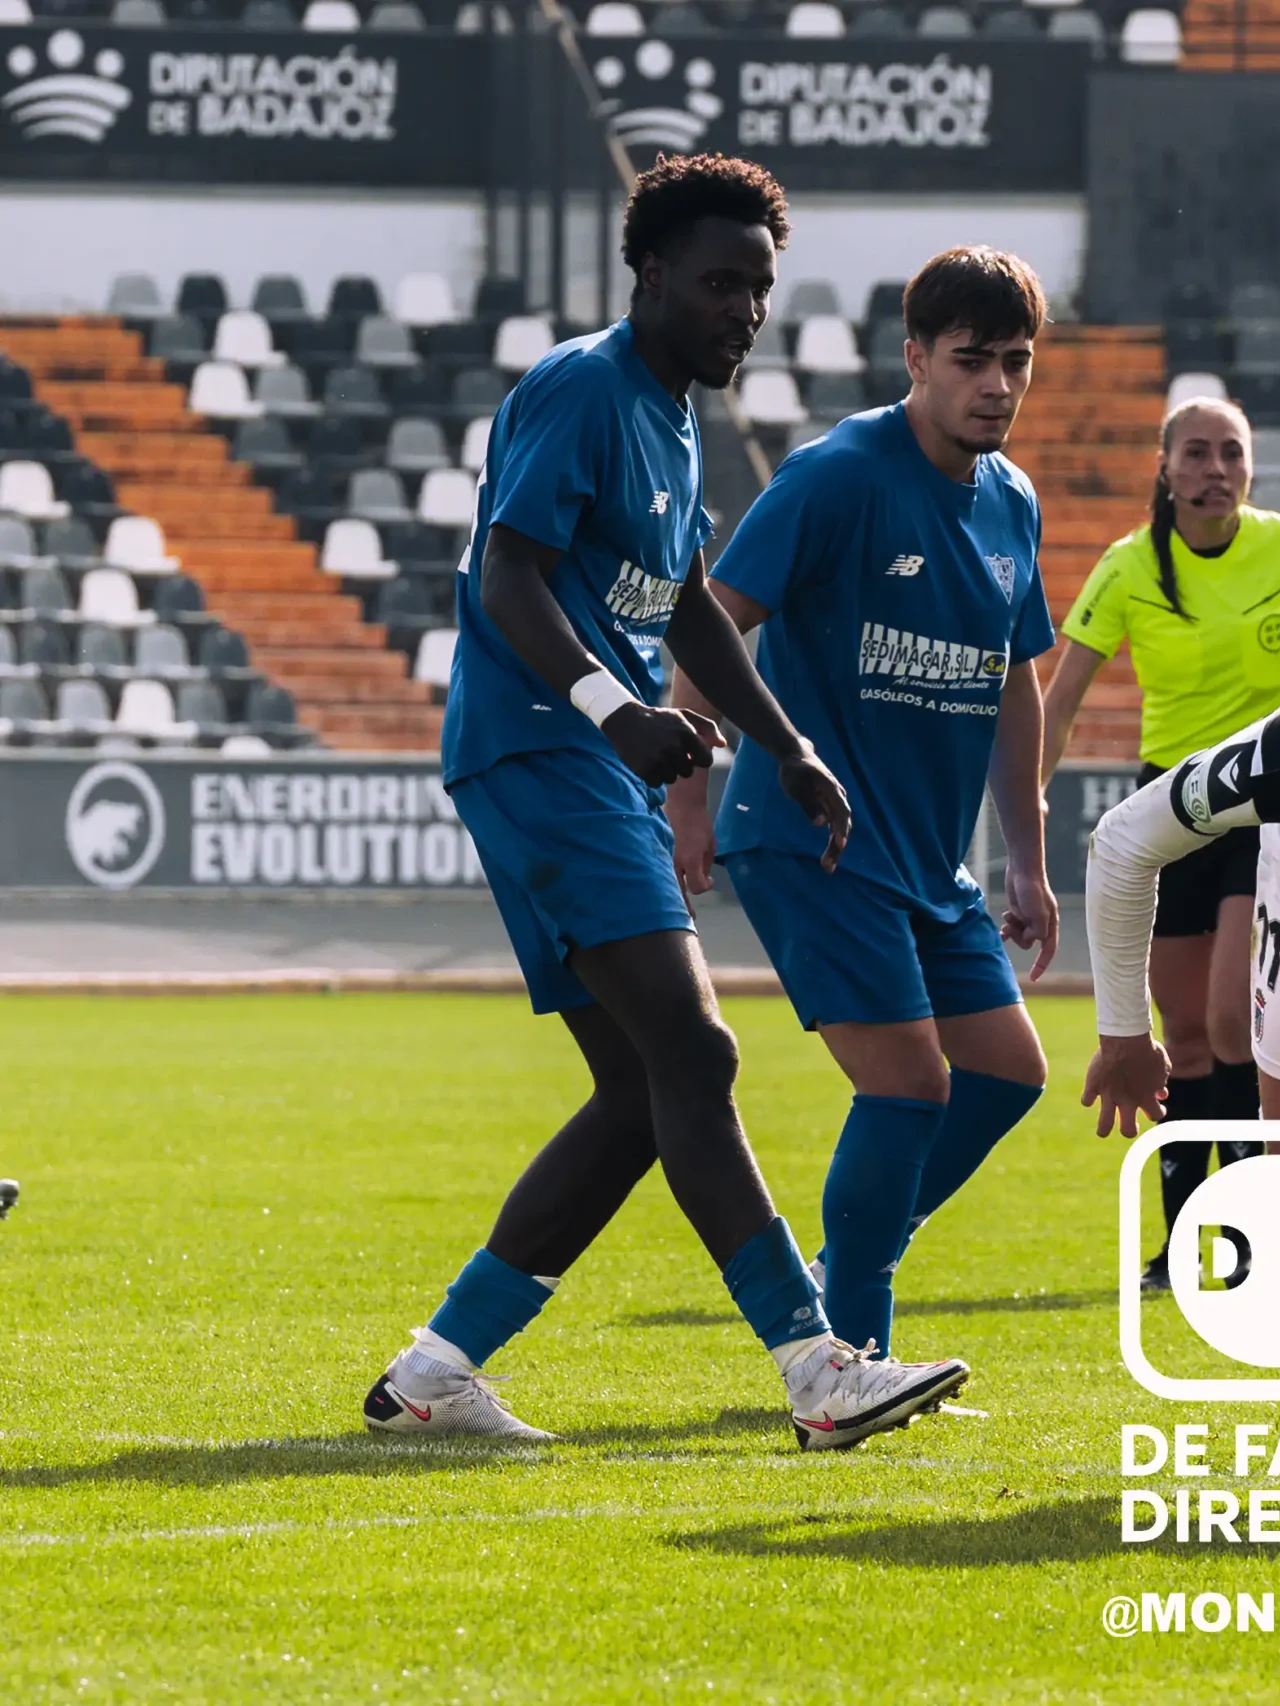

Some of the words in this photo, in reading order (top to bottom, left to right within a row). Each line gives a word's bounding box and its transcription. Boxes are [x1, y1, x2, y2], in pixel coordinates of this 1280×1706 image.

[148, 46, 396, 96] DIPUTACIÓN
[739, 54, 991, 104] DIPUTACIÓN
[148, 104, 189, 136] DE
[197, 99, 396, 140] BADAJOZ
[739, 111, 781, 143] DE
[789, 107, 990, 147] BADAJOZ
[860, 687, 923, 707] GASÓLEOS
[926, 700, 936, 711] A
[940, 702, 998, 716] DOMICILIO
[190, 773, 461, 821] ENERDRIN
